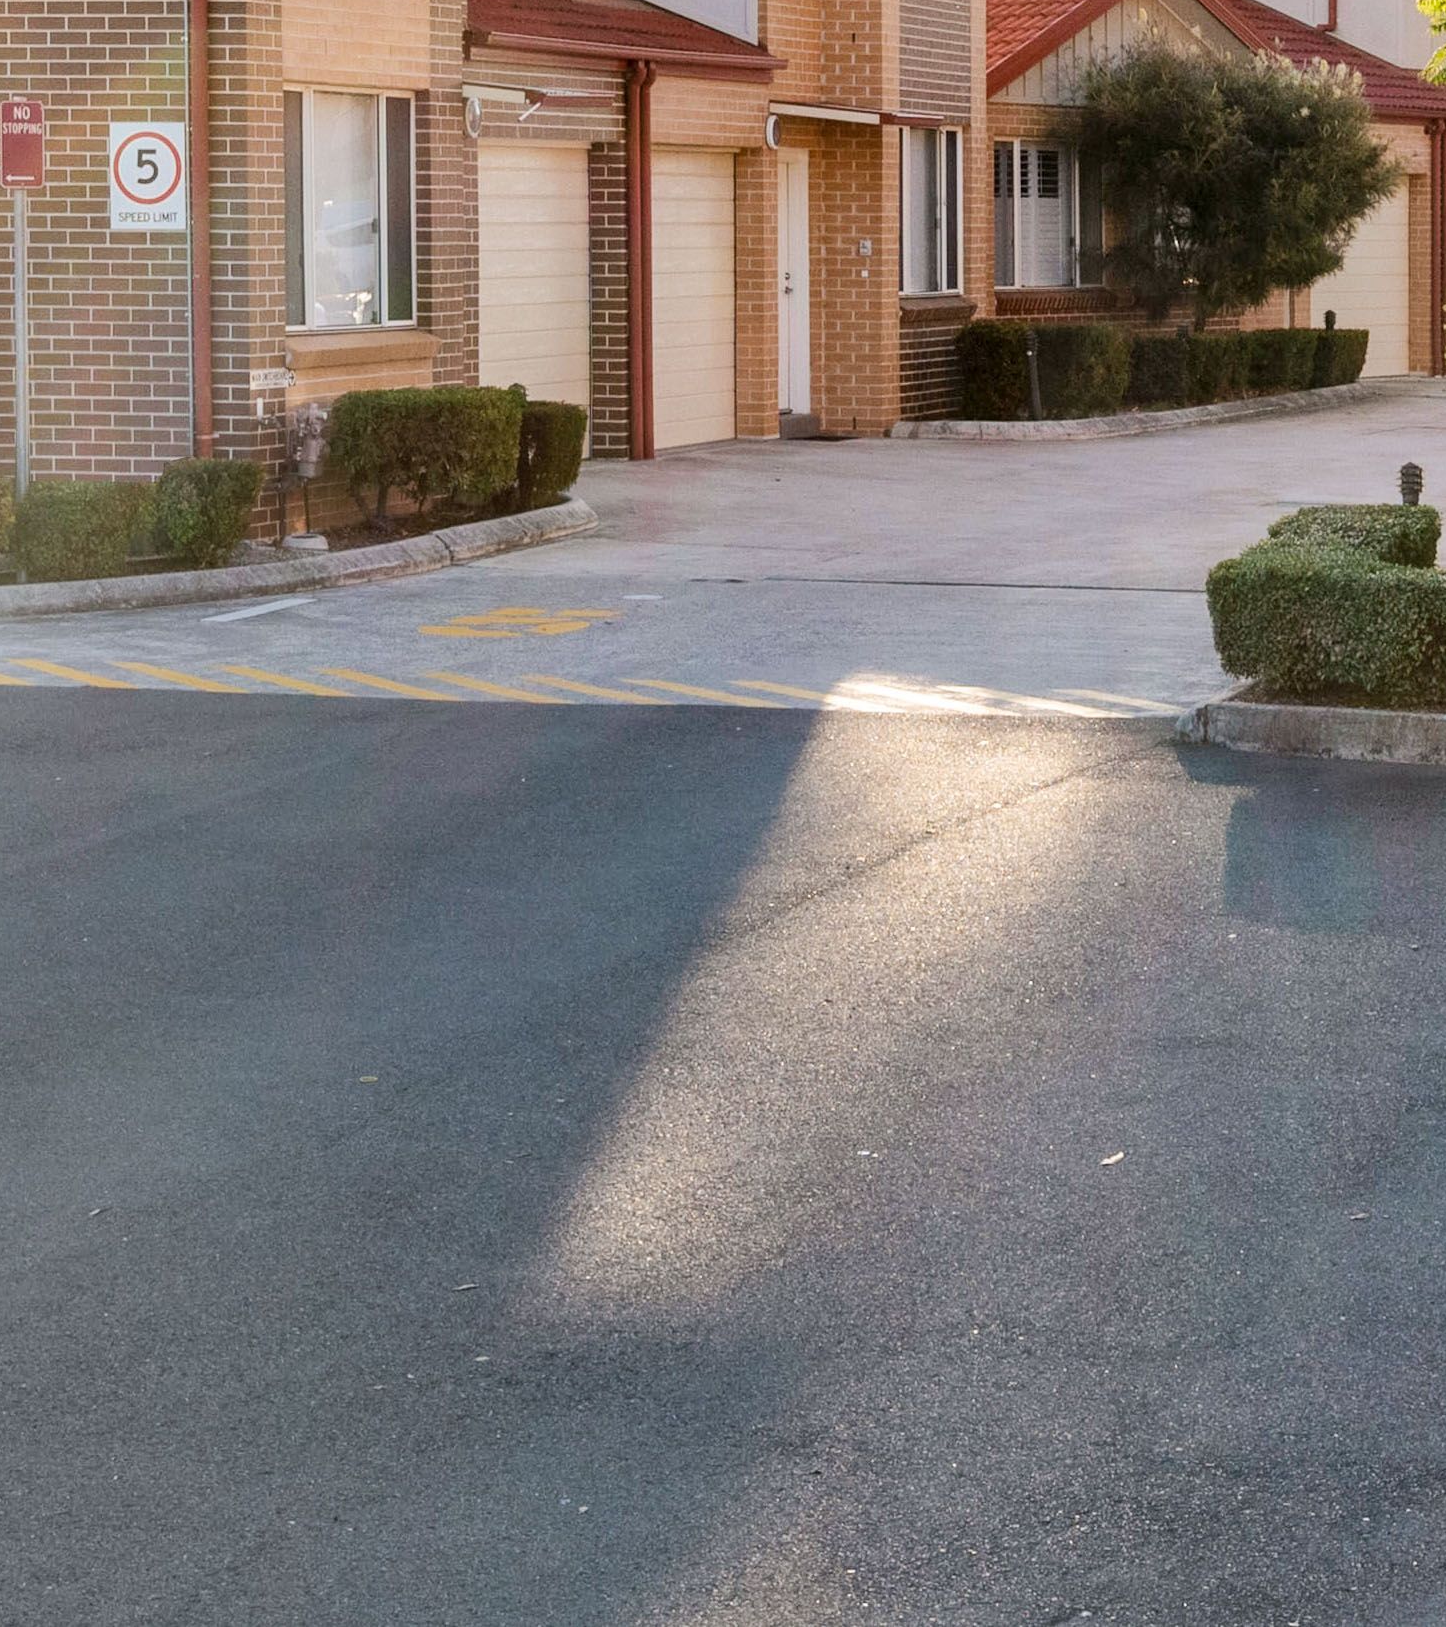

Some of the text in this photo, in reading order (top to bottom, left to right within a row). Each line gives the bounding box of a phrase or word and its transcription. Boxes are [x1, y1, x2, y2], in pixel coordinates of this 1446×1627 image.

[13, 105, 31, 120] NO
[2, 122, 42, 135] STOPPING
[136, 149, 159, 184] 5
[118, 212, 178, 222] SPEED LIMIT
